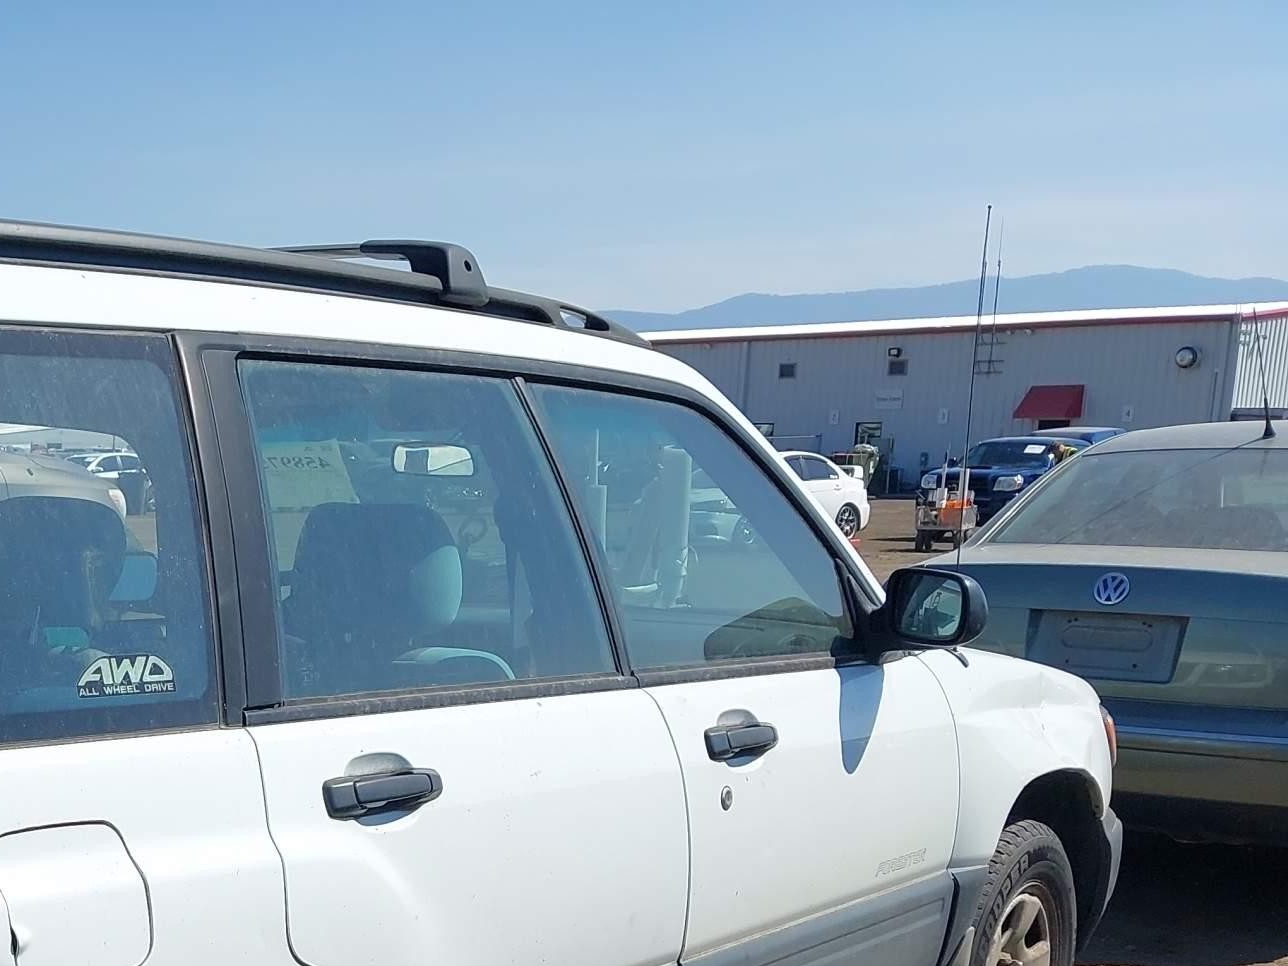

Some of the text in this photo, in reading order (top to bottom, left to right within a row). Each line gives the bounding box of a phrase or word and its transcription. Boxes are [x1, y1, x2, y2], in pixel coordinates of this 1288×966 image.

[78, 655, 174, 686] AWD
[79, 682, 175, 697] ALL WHEEL DRIVE
